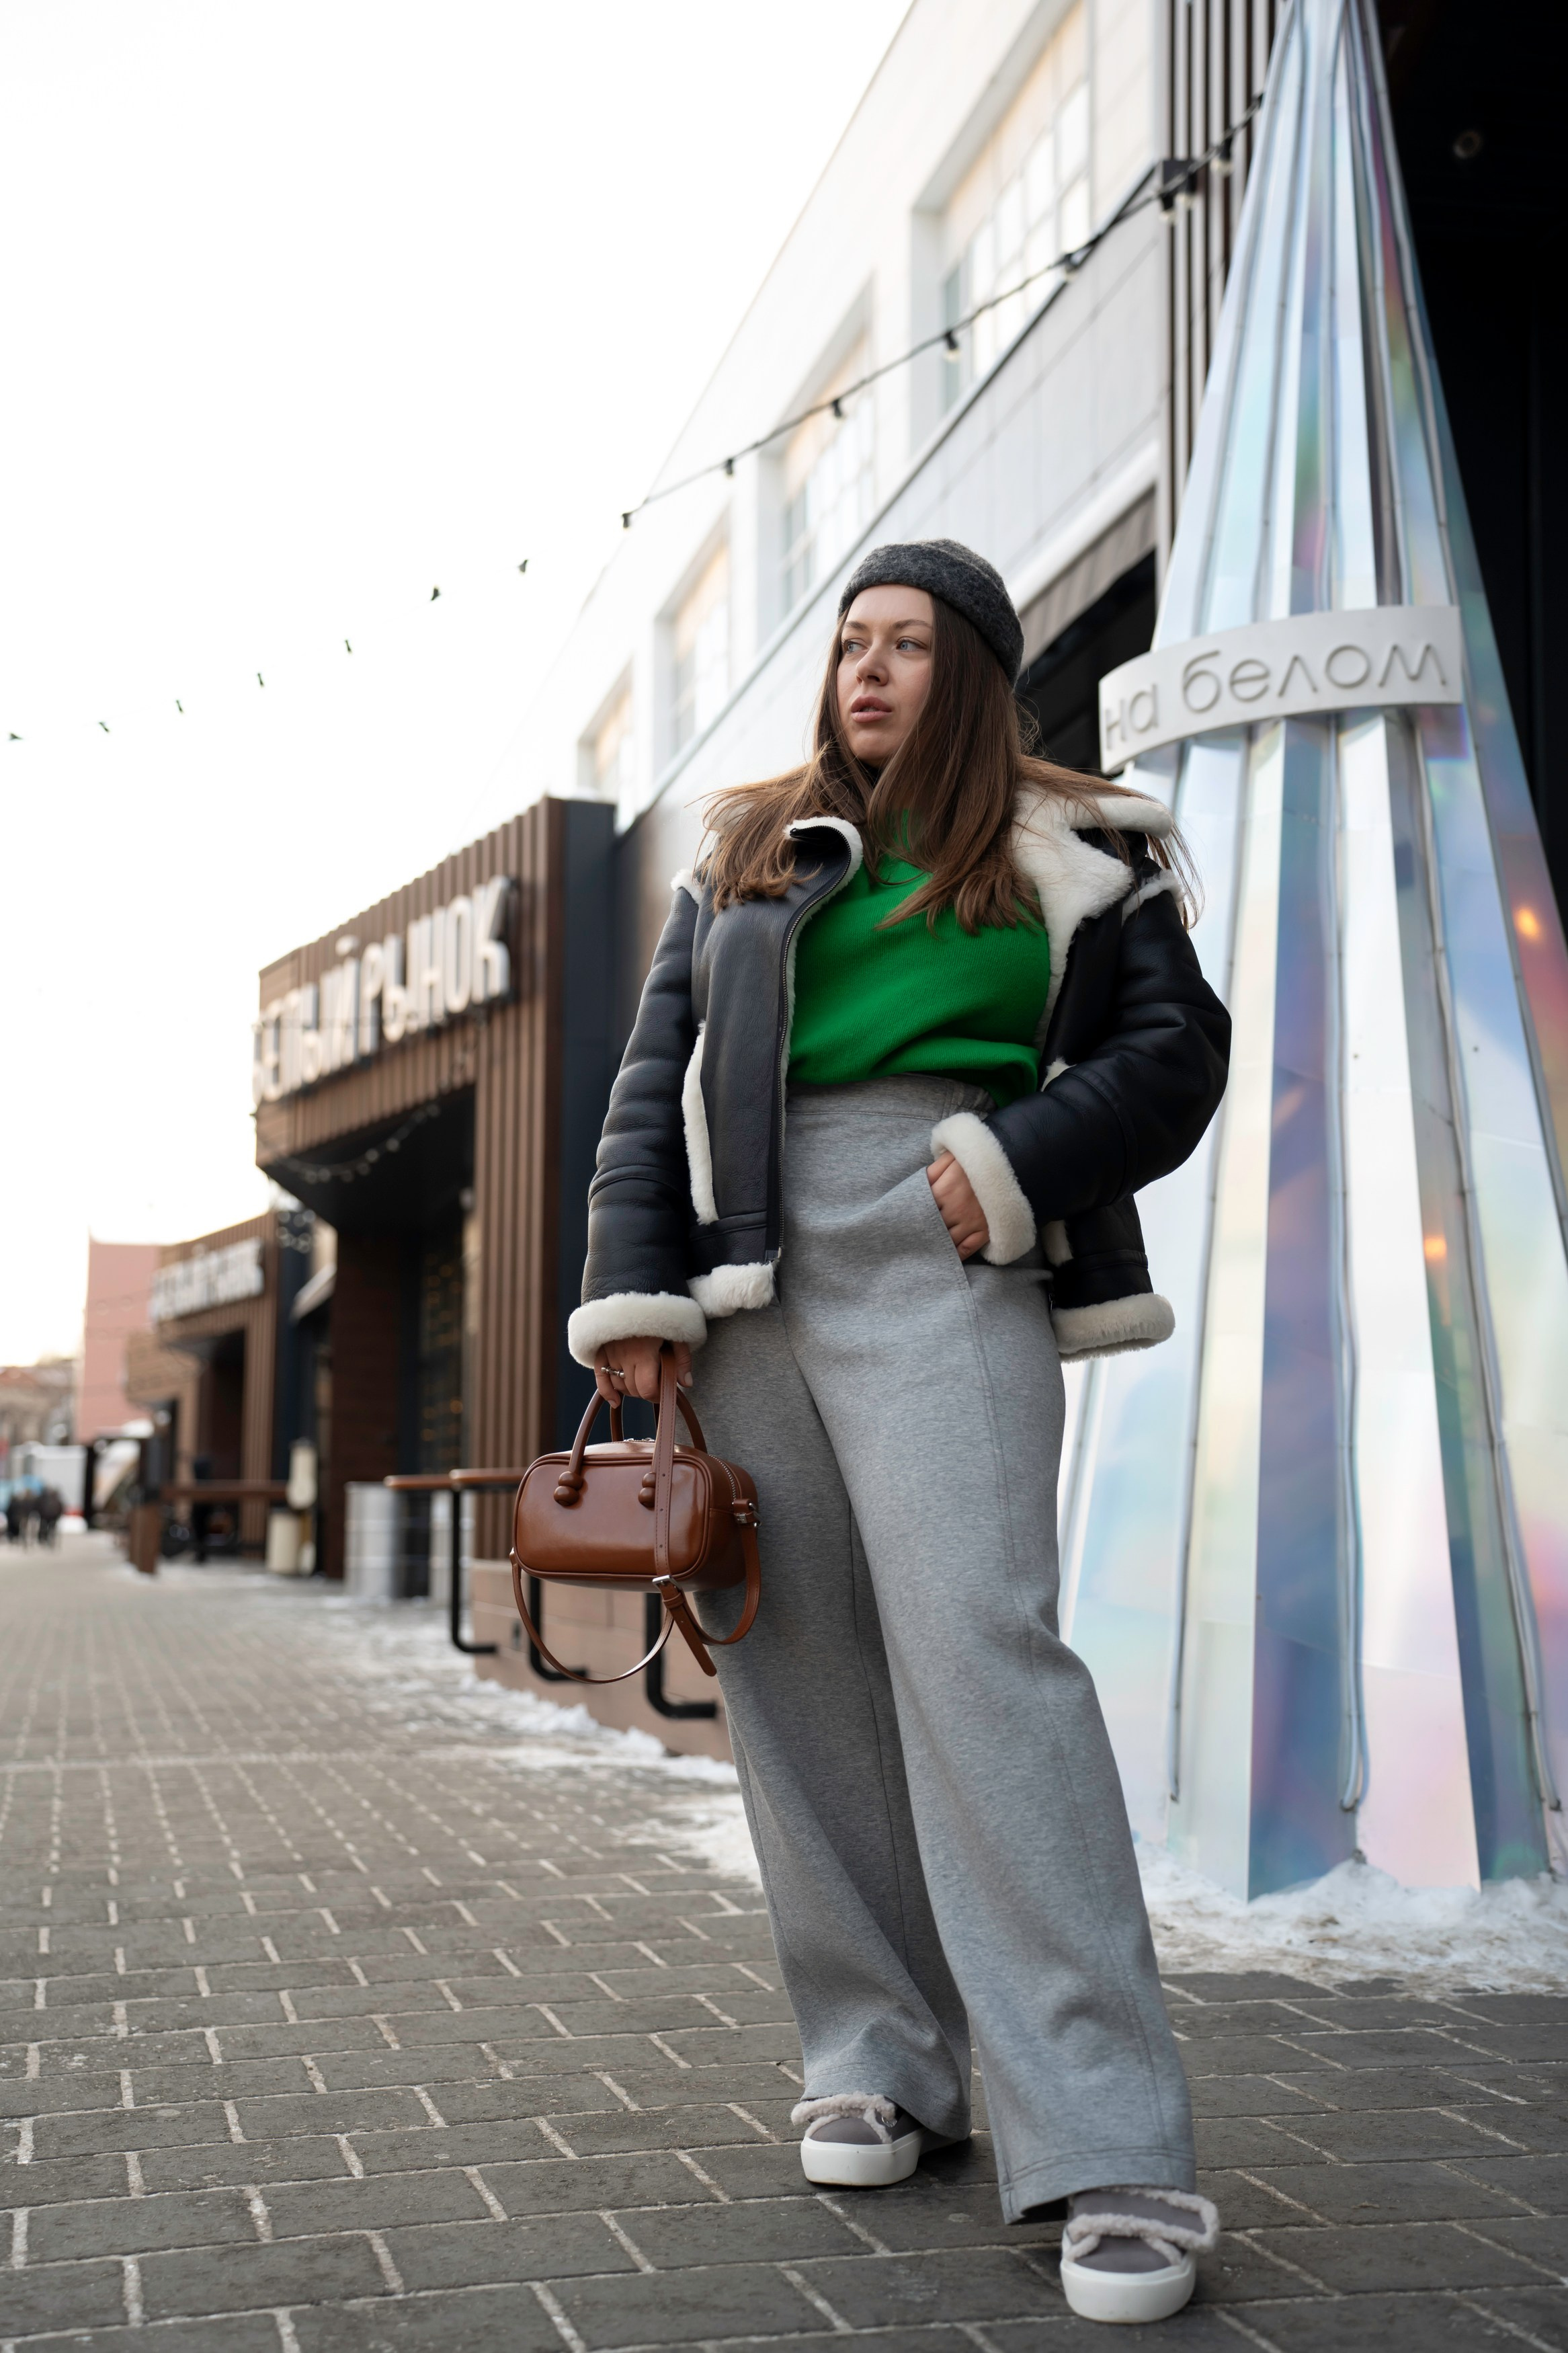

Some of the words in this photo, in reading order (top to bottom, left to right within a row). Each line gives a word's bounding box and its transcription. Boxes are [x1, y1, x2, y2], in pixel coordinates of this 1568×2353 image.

[1104, 683, 1159, 751] на
[1182, 643, 1447, 713] белом
[359, 874, 511, 1057] РЫНОК
